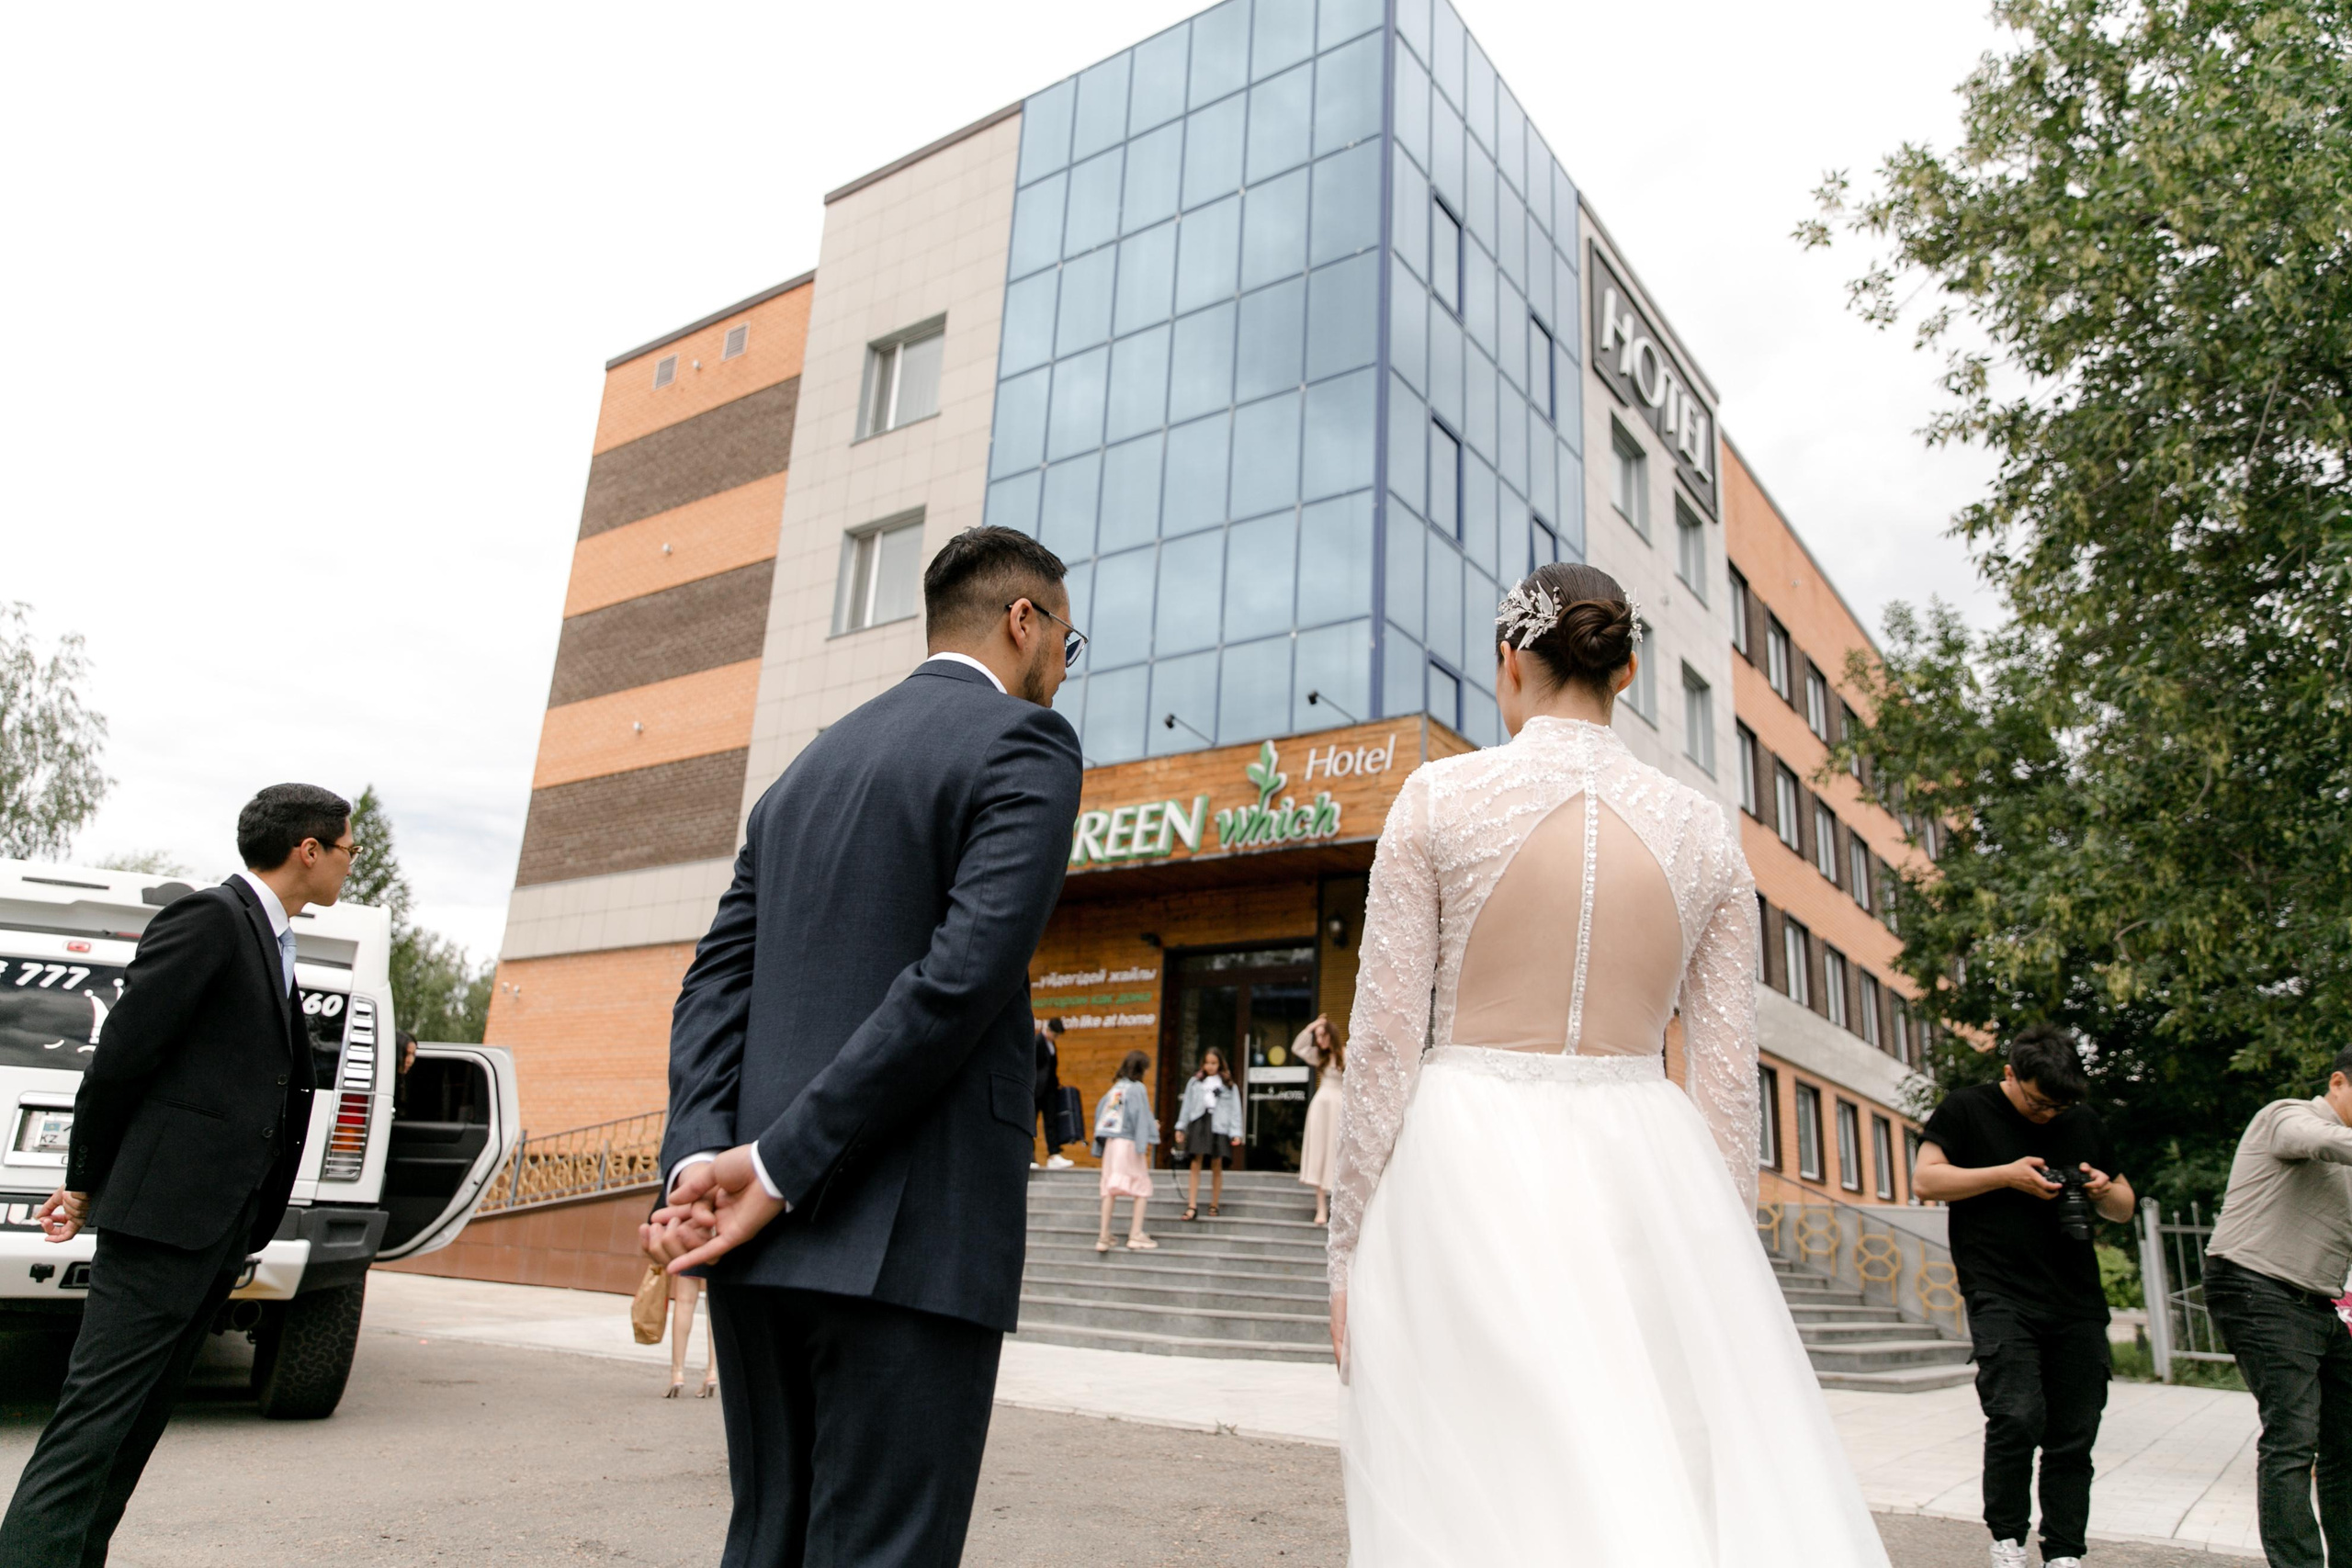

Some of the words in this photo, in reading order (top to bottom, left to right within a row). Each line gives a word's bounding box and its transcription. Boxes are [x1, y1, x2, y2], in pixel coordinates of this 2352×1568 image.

[1601, 287, 1713, 484] HOTEL
[1305, 734, 1397, 782] Hotel
[1068, 794, 1209, 865] REEN
[1216, 788, 1342, 850] which
[15, 962, 91, 990] 777
[299, 989, 344, 1018] 60
[1079, 1014, 1102, 1029] like
[1102, 1013, 1117, 1028] at
[1116, 1012, 1156, 1027] home
[40, 1134, 58, 1144] KZ
